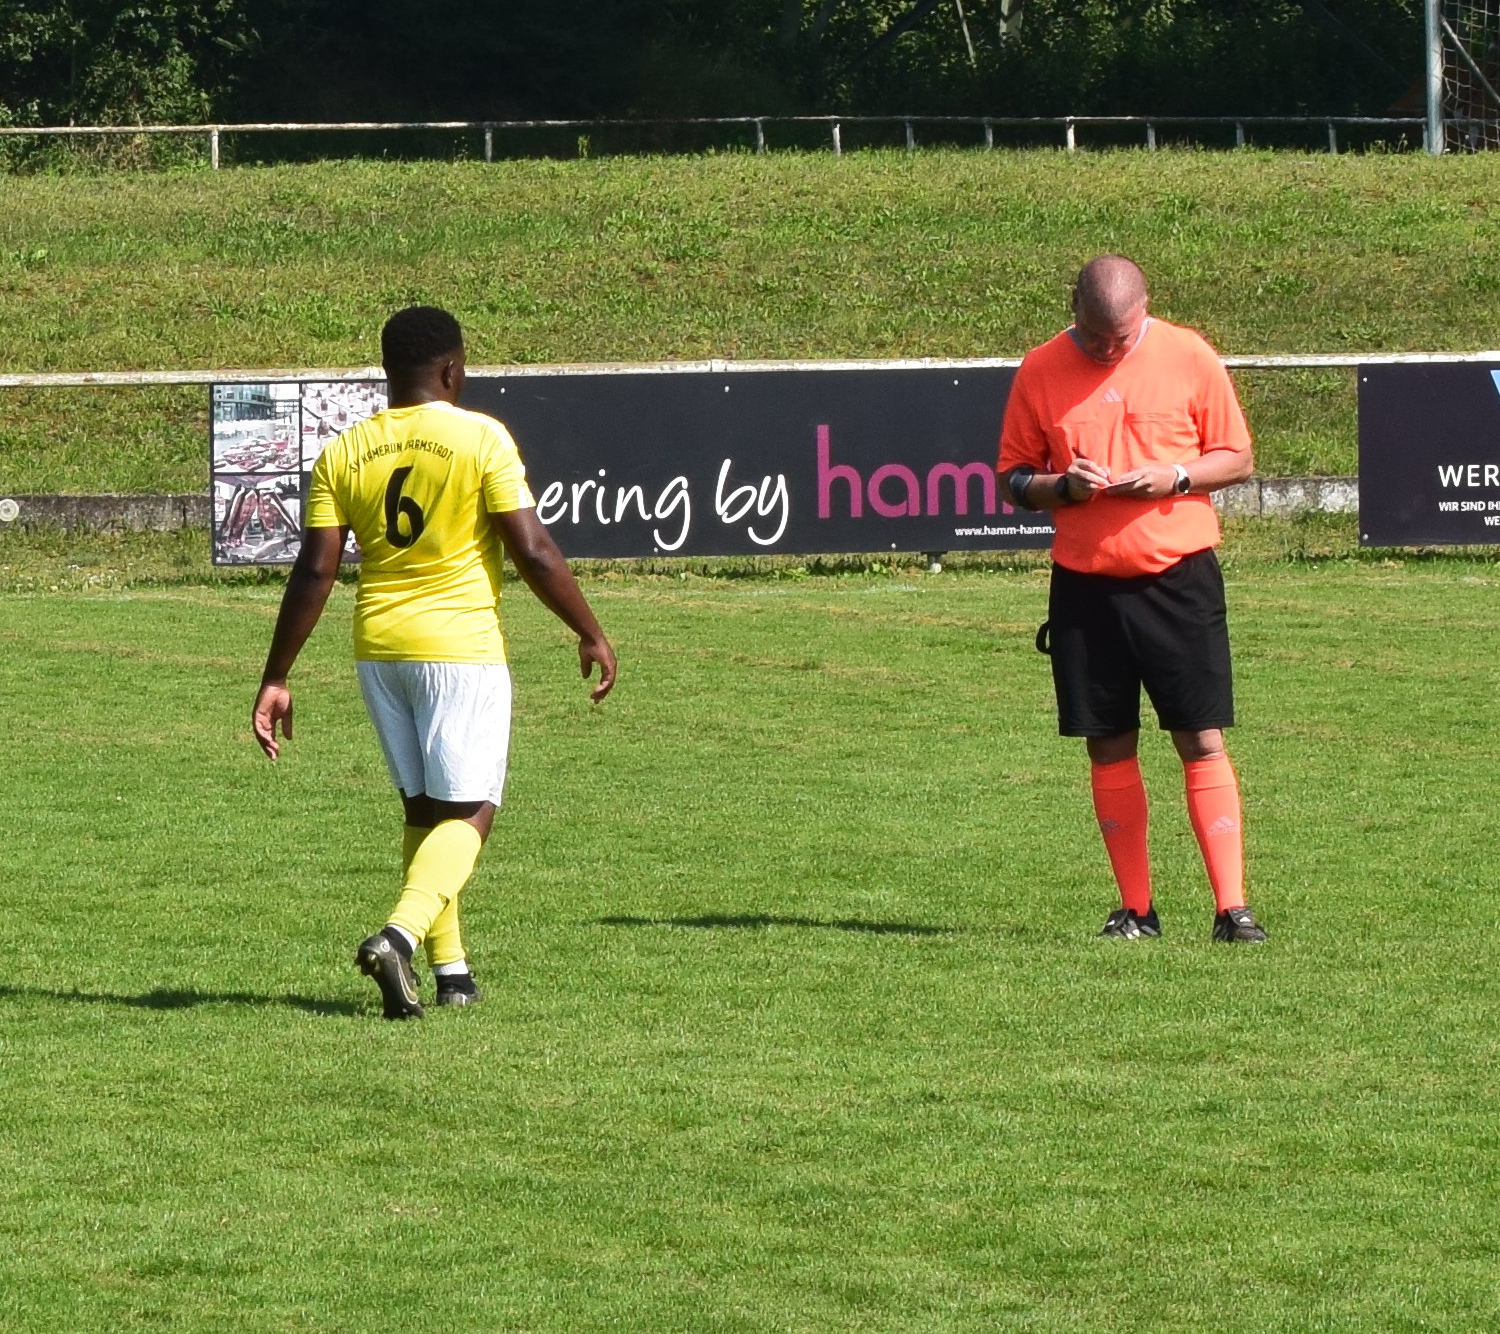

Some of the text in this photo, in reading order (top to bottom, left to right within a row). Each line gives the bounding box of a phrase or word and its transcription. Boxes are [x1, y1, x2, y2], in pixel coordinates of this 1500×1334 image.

[384, 466, 424, 549] 6
[536, 469, 691, 551] ering
[715, 459, 789, 546] by
[1439, 501, 1459, 511] WIR
[1460, 500, 1486, 511] SIND
[955, 525, 1056, 536] www.hamm-hamm.
